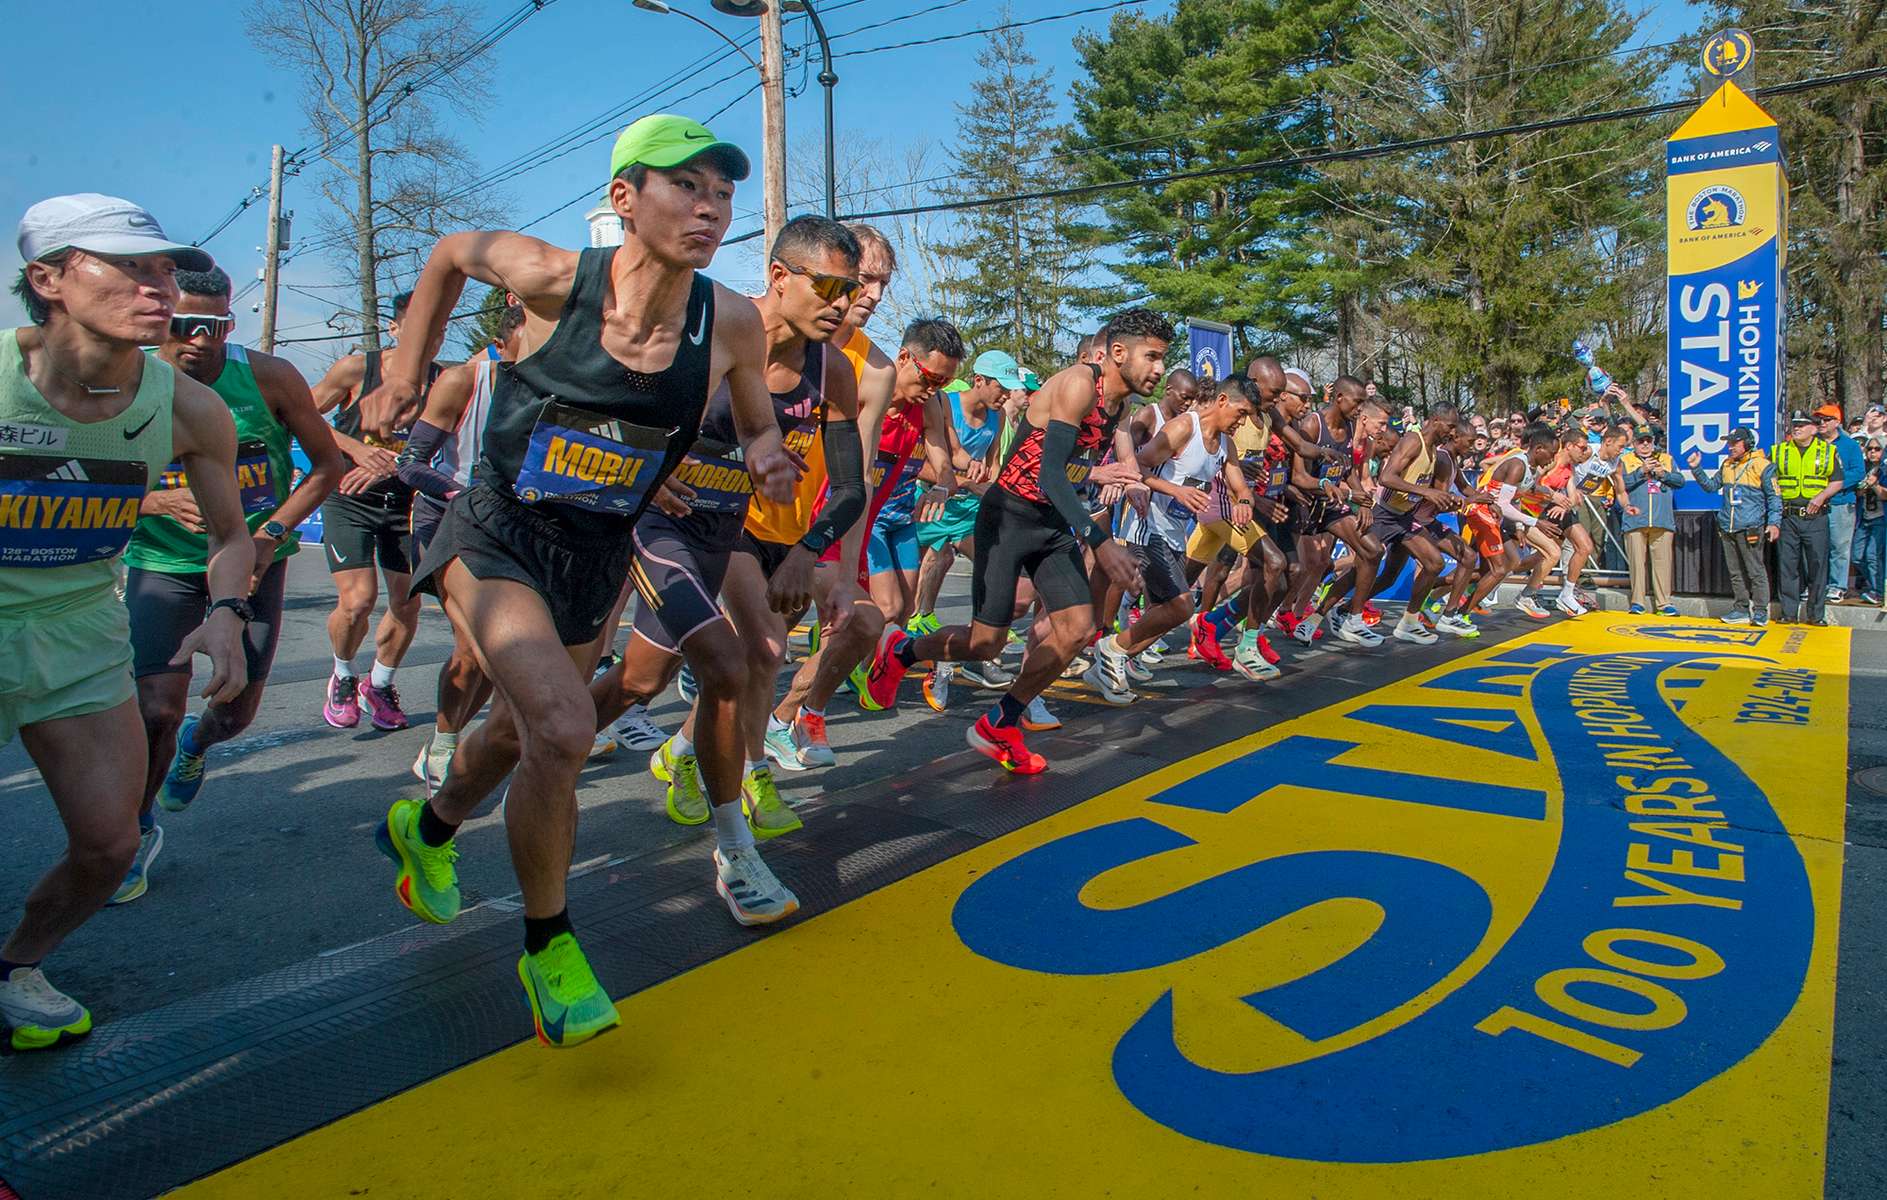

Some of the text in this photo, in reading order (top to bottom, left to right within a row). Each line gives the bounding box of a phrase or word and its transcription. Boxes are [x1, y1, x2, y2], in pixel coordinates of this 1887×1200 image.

[1671, 146, 1751, 164] BANK OF AMERICA
[1691, 187, 1718, 208] BOSTON
[1721, 187, 1745, 221] MARATHON
[1679, 235, 1699, 243] BANK
[1711, 231, 1747, 240] AMERICA
[1, 554, 77, 562] MARATHON
[31, 547, 78, 555] BOSTON
[1568, 655, 1663, 739] HOPKINTON
[1733, 666, 1819, 725] 1924-2024
[1596, 742, 1694, 771] IN
[1612, 774, 1745, 911] YEARS
[1473, 928, 1727, 1069] 100
